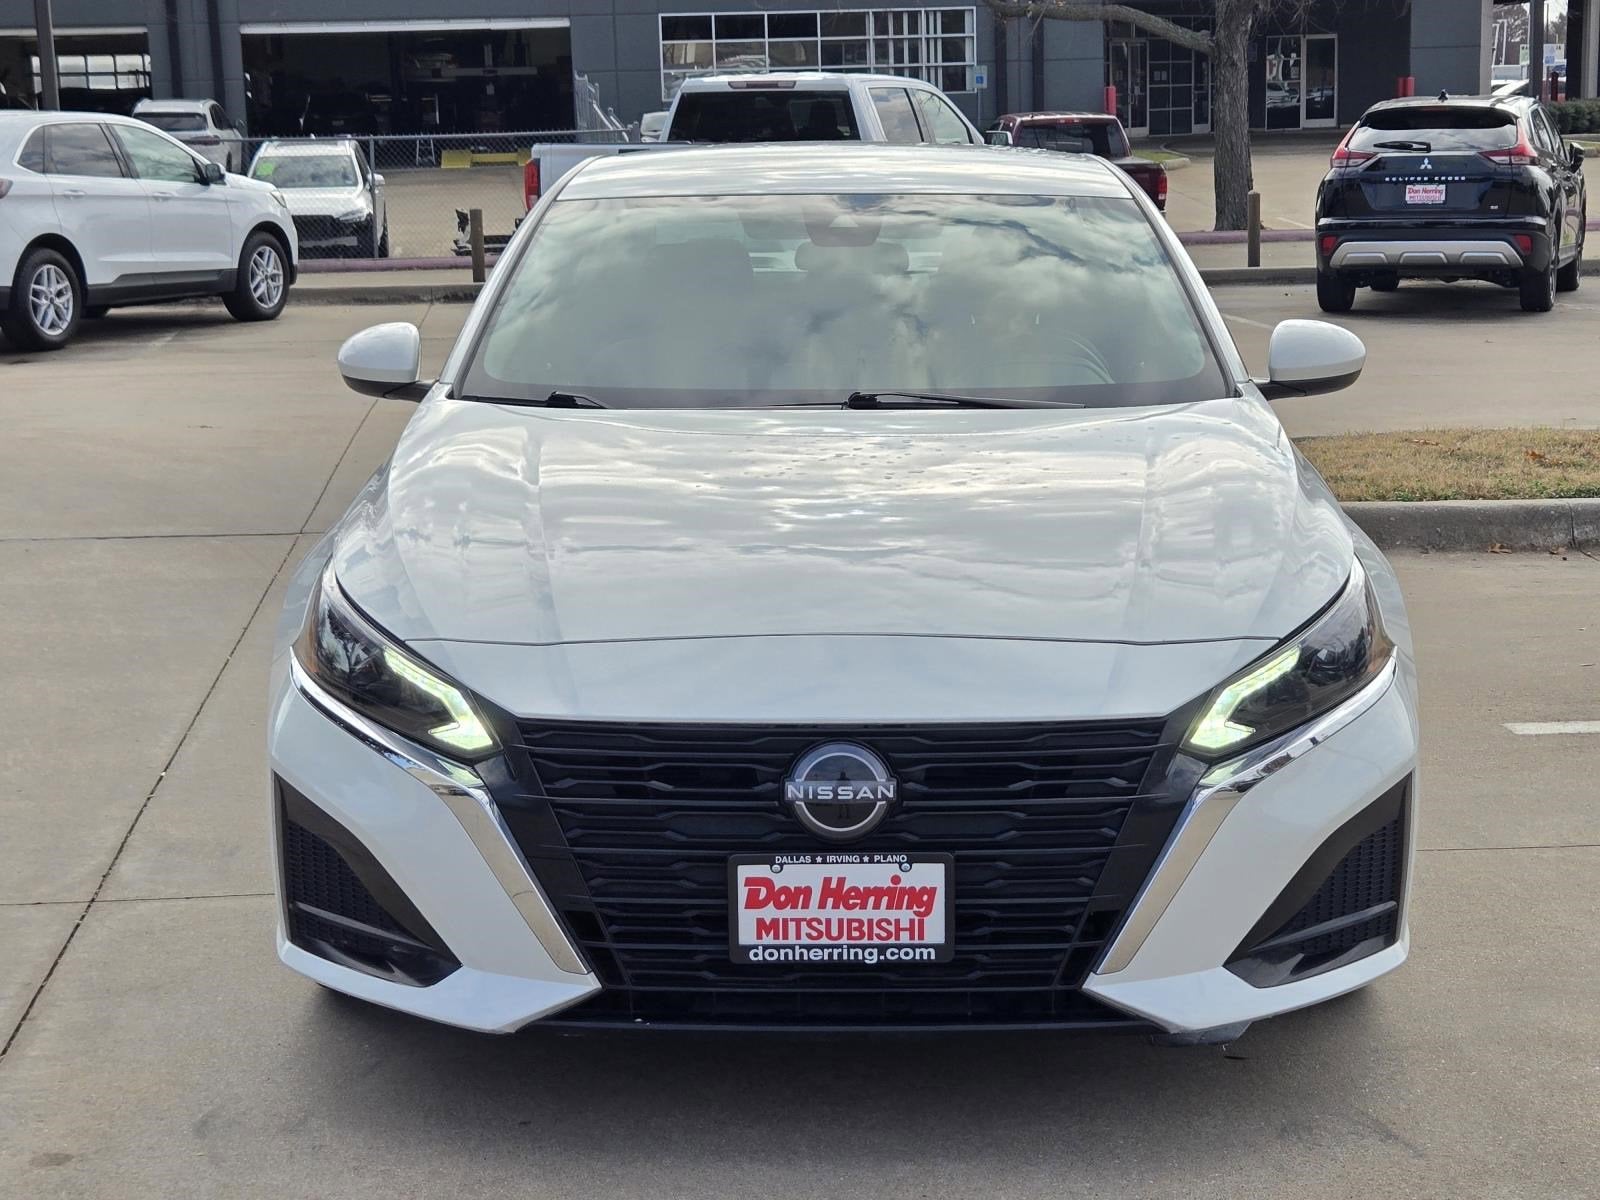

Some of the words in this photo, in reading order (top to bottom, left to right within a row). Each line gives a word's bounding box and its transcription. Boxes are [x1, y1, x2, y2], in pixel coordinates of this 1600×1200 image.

[787, 784, 894, 800] NISSAN
[775, 855, 812, 864] DALLAS
[826, 855, 860, 863] IRVING
[874, 854, 908, 863] PLANO
[744, 876, 813, 910] Don
[817, 874, 937, 918] Herring
[756, 917, 925, 941] MITSUBISHI
[749, 945, 936, 964] donherring.com
